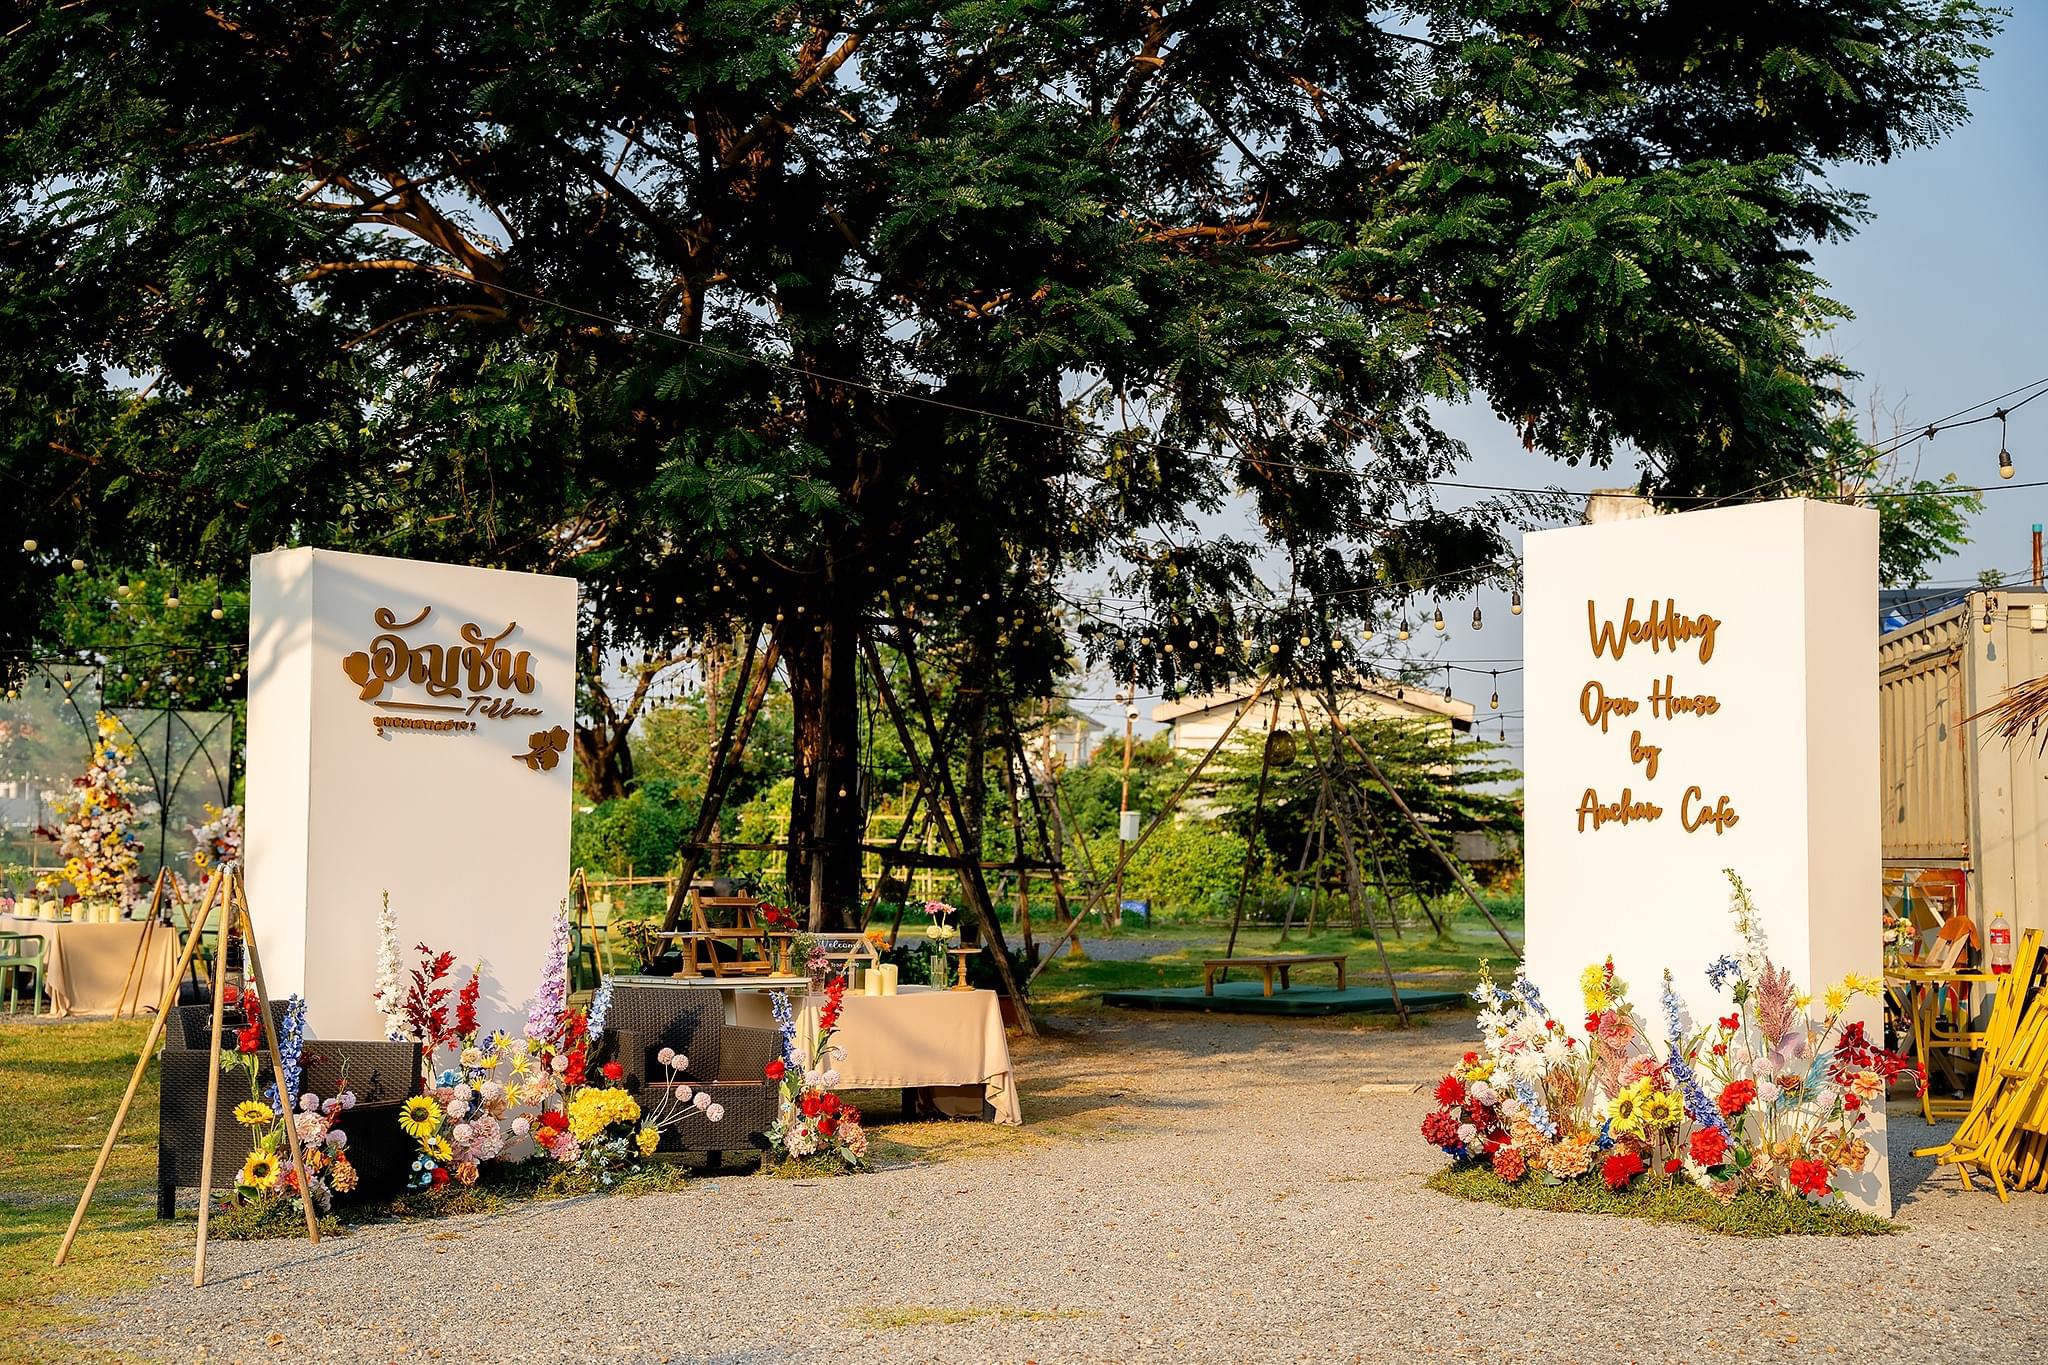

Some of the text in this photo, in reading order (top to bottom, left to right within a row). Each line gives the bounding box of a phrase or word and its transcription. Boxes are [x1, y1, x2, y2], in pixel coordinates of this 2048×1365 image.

[370, 606, 535, 698] อัญชัน
[1588, 598, 1721, 664] Wedding
[466, 695, 543, 719] Terrace
[1580, 675, 1721, 734] Open House
[1630, 730, 1662, 780] by
[1576, 786, 1739, 835] Anchan Cafe
